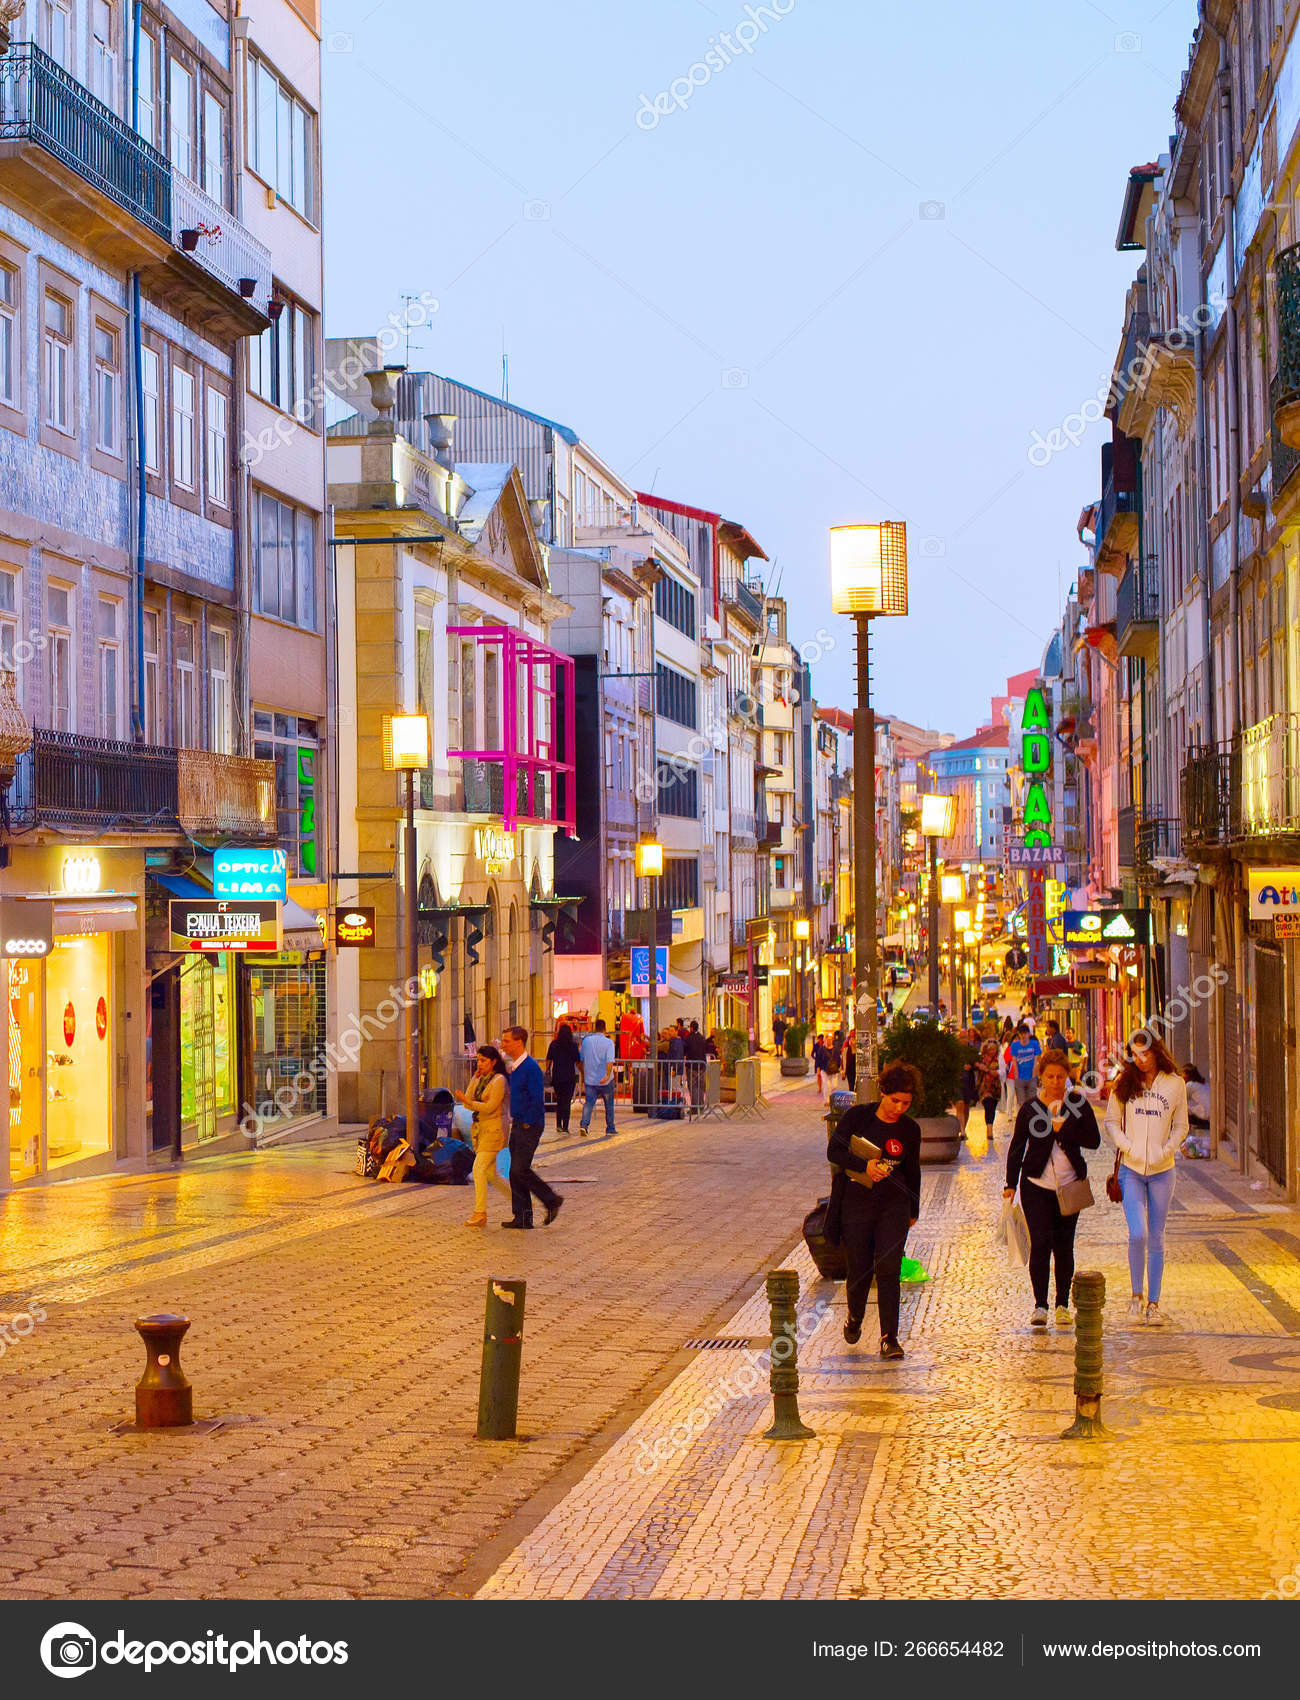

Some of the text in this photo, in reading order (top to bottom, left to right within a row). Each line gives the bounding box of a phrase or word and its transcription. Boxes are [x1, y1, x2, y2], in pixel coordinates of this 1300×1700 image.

[1010, 848, 1062, 863] BAZAR
[217, 862, 282, 874] OPTICA
[217, 882, 282, 893] LIMA
[1257, 885, 1300, 905] Ati
[187, 914, 261, 931] PAULA TEIXEIRA
[1029, 867, 1045, 971] MABRIL
[6, 940, 46, 953] ecco
[635, 972, 663, 983] YOA
